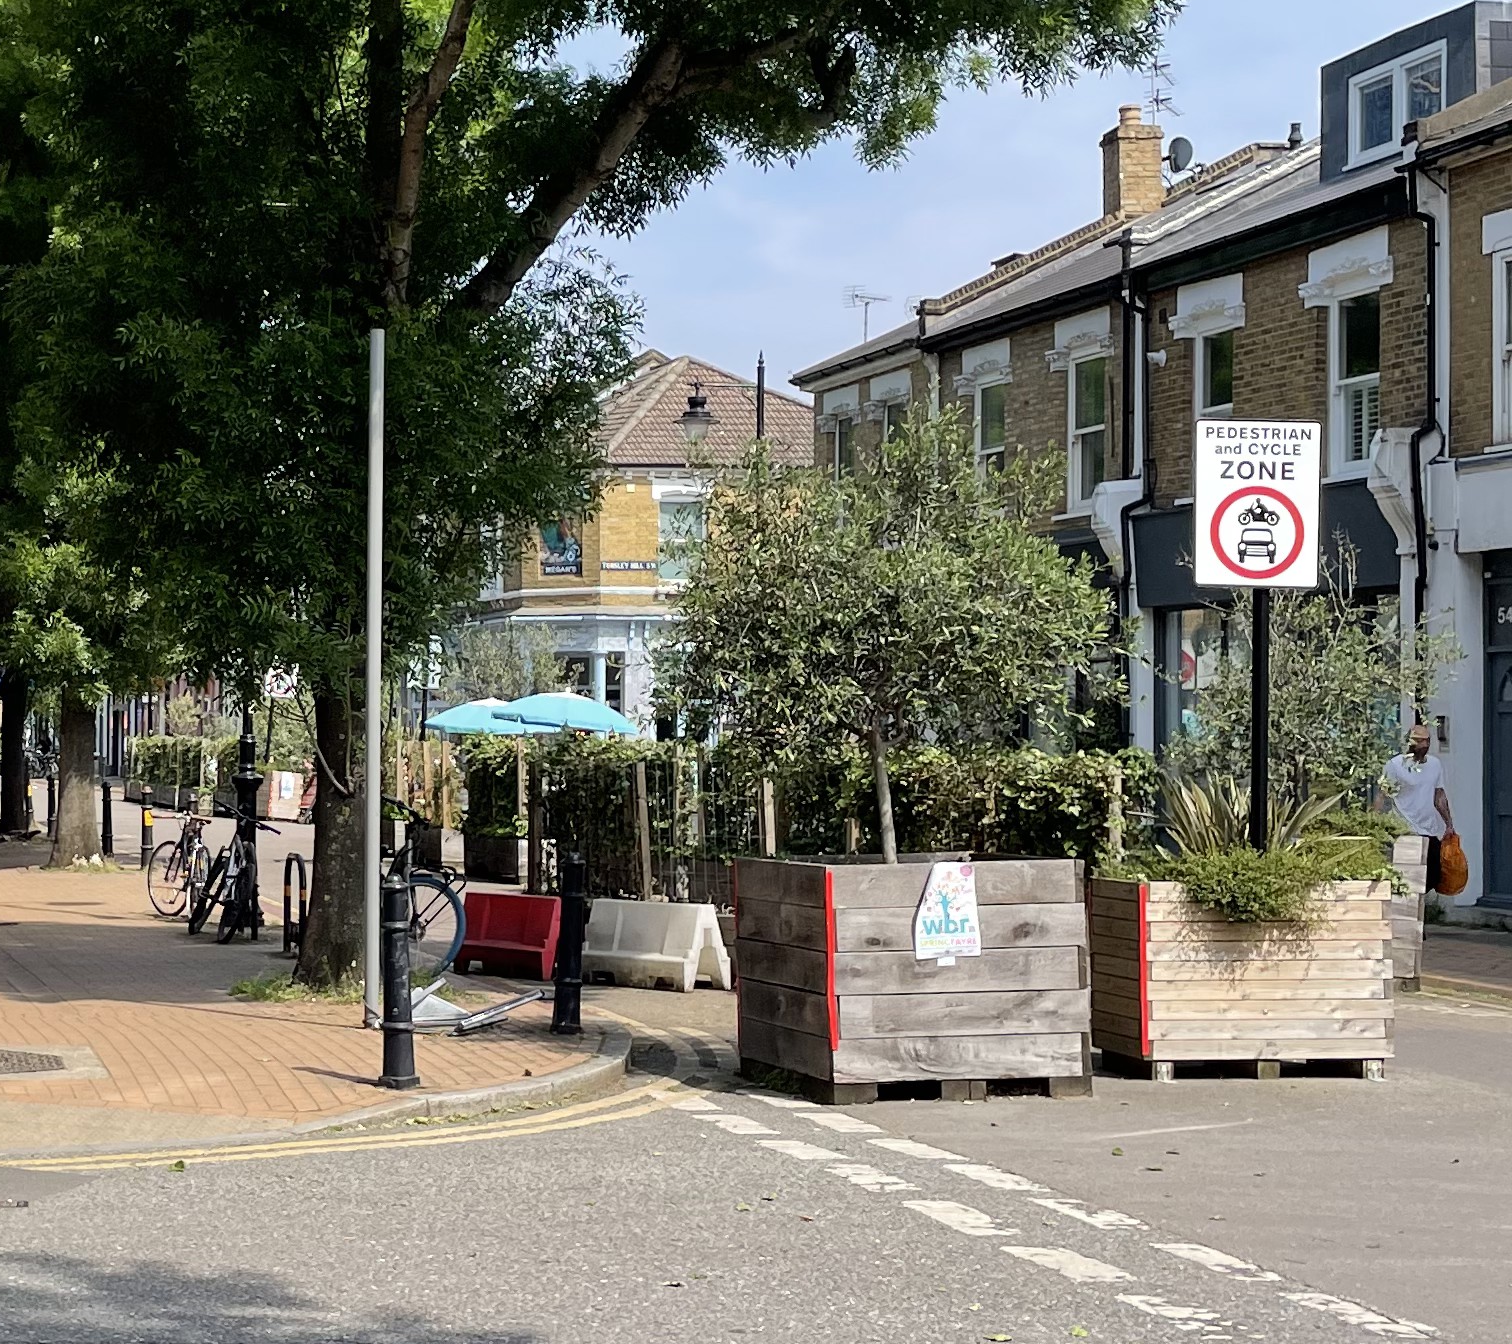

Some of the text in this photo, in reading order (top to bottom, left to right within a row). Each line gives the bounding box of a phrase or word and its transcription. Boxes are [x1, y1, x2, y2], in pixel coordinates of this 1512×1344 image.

[1205, 426, 1313, 440] PEDESTRIAN
[1214, 443, 1302, 456] and CYCLE
[1220, 460, 1295, 481] ZONE
